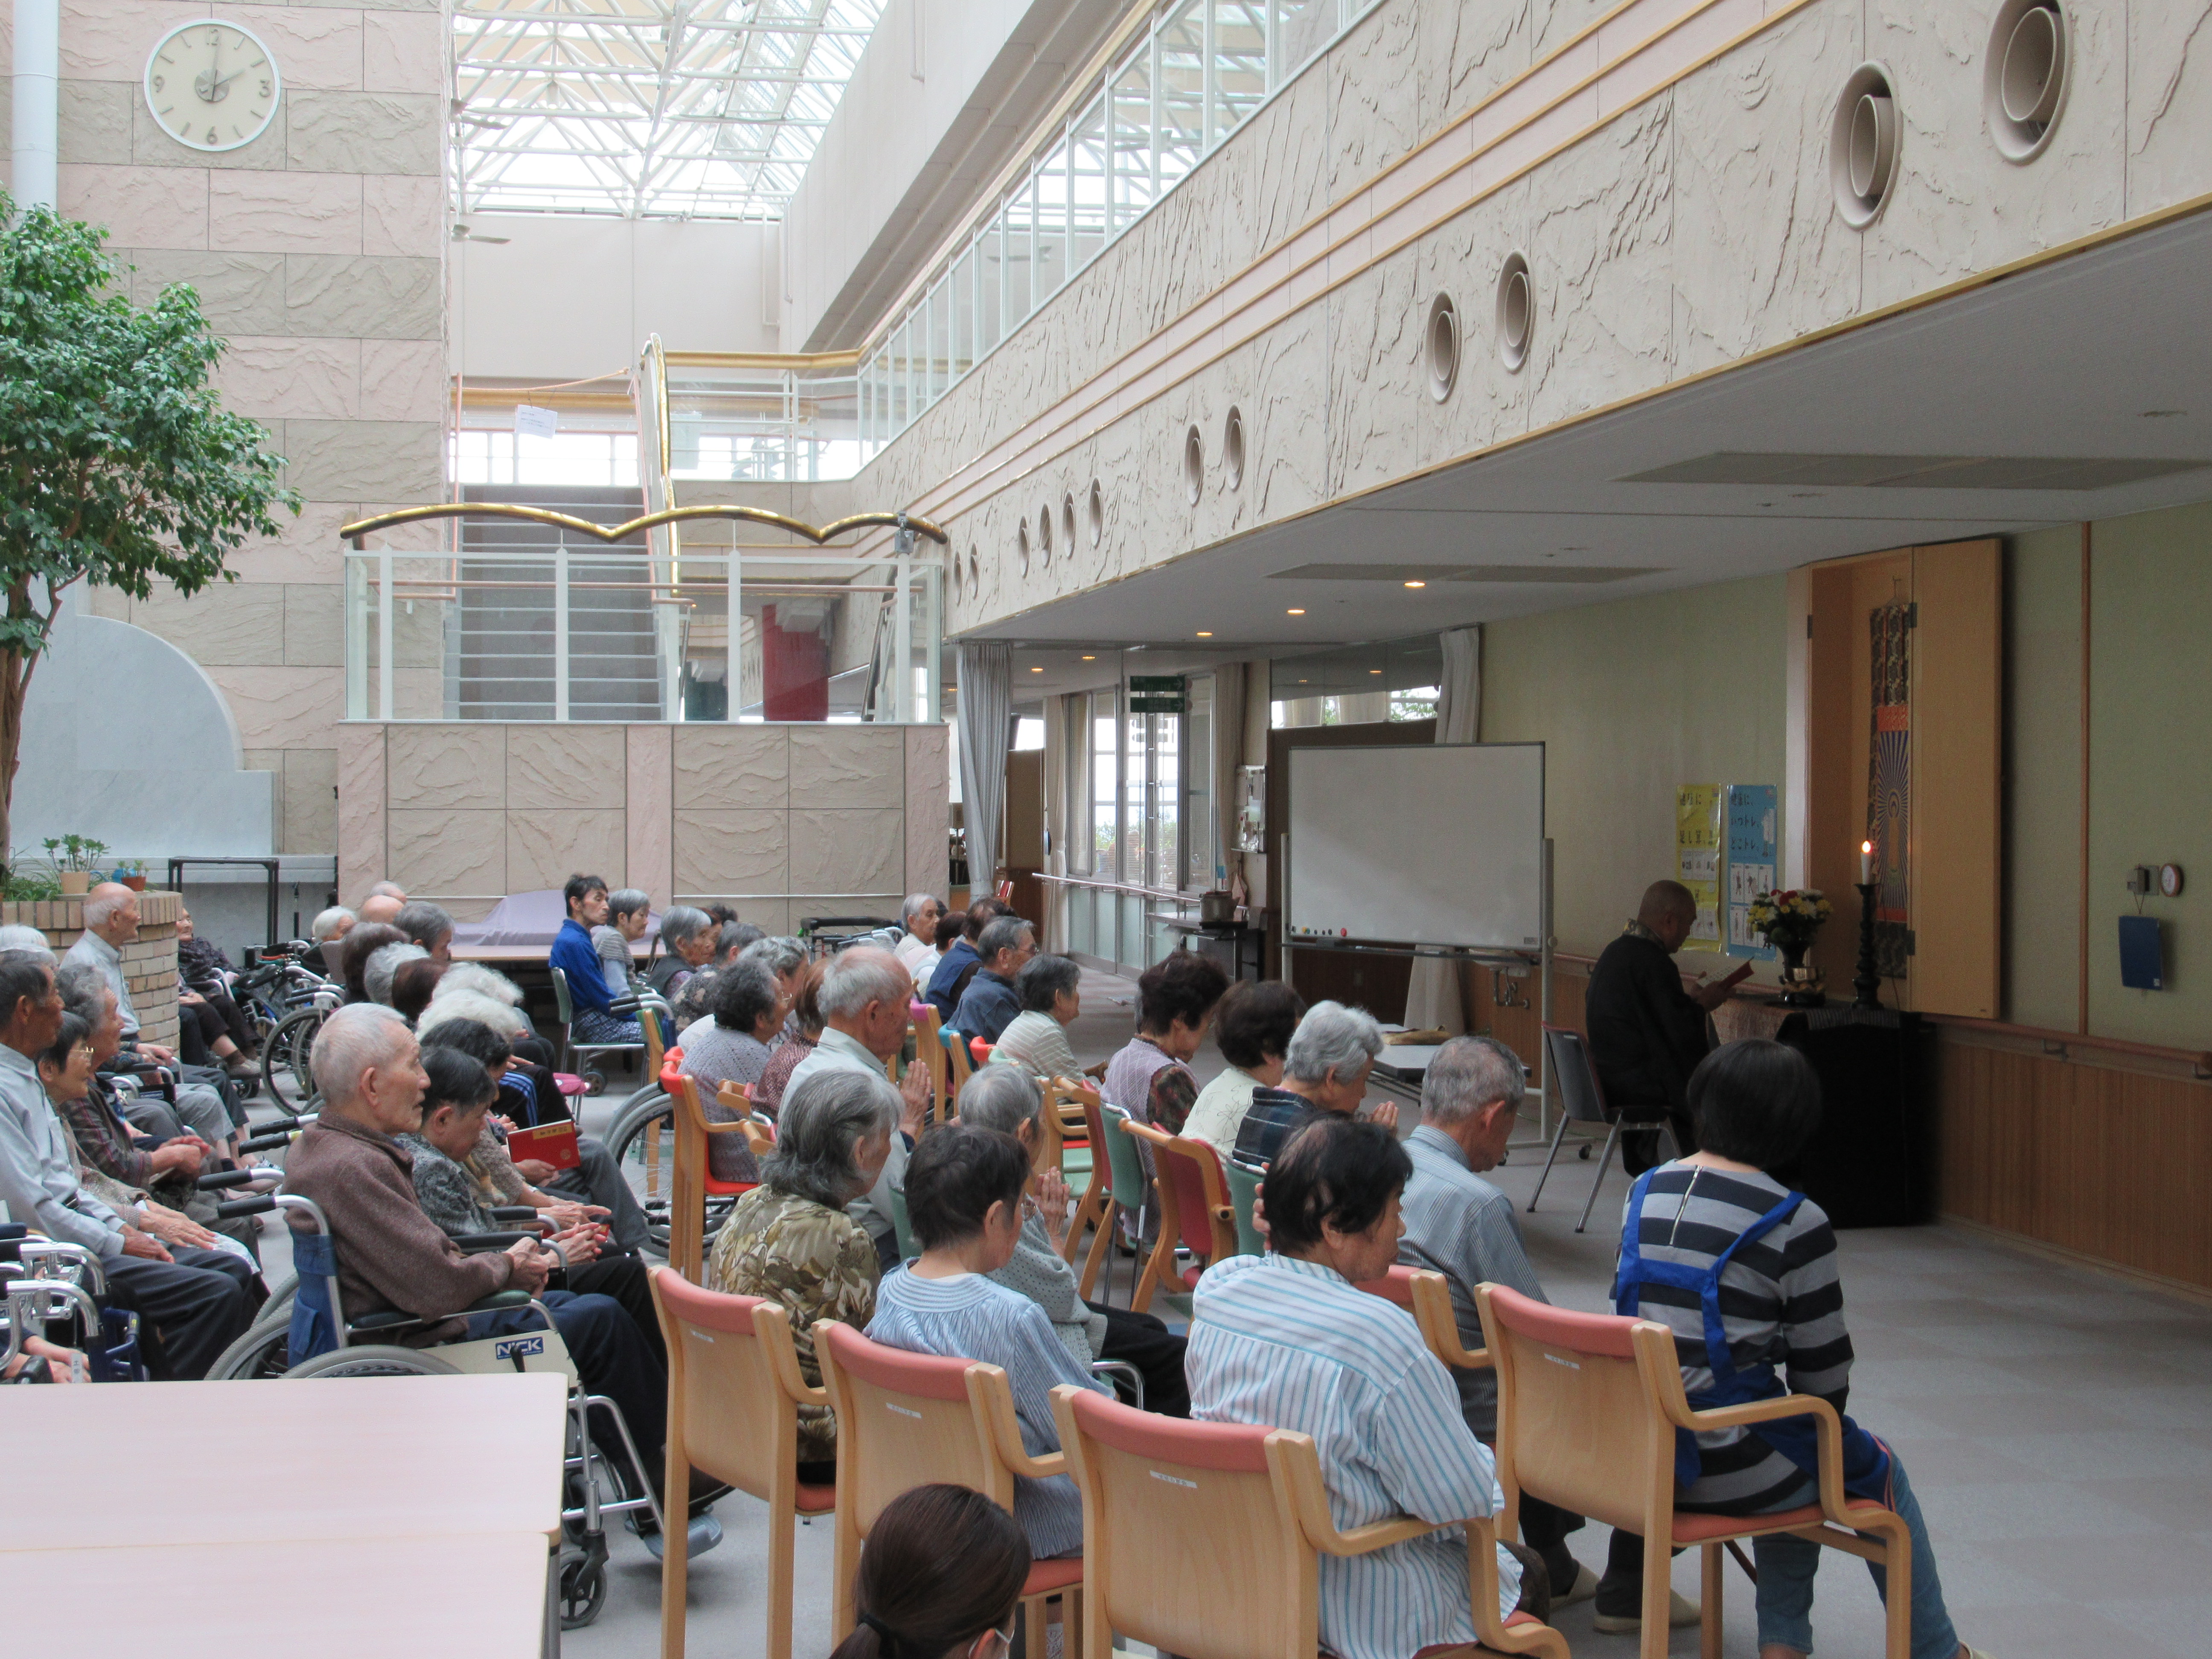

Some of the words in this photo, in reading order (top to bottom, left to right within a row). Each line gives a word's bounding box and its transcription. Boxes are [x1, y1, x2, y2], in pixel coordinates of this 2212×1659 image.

[207, 27, 220, 46] 12
[153, 74, 165, 93] 9
[259, 79, 271, 97] 3
[207, 126, 218, 144] 6
